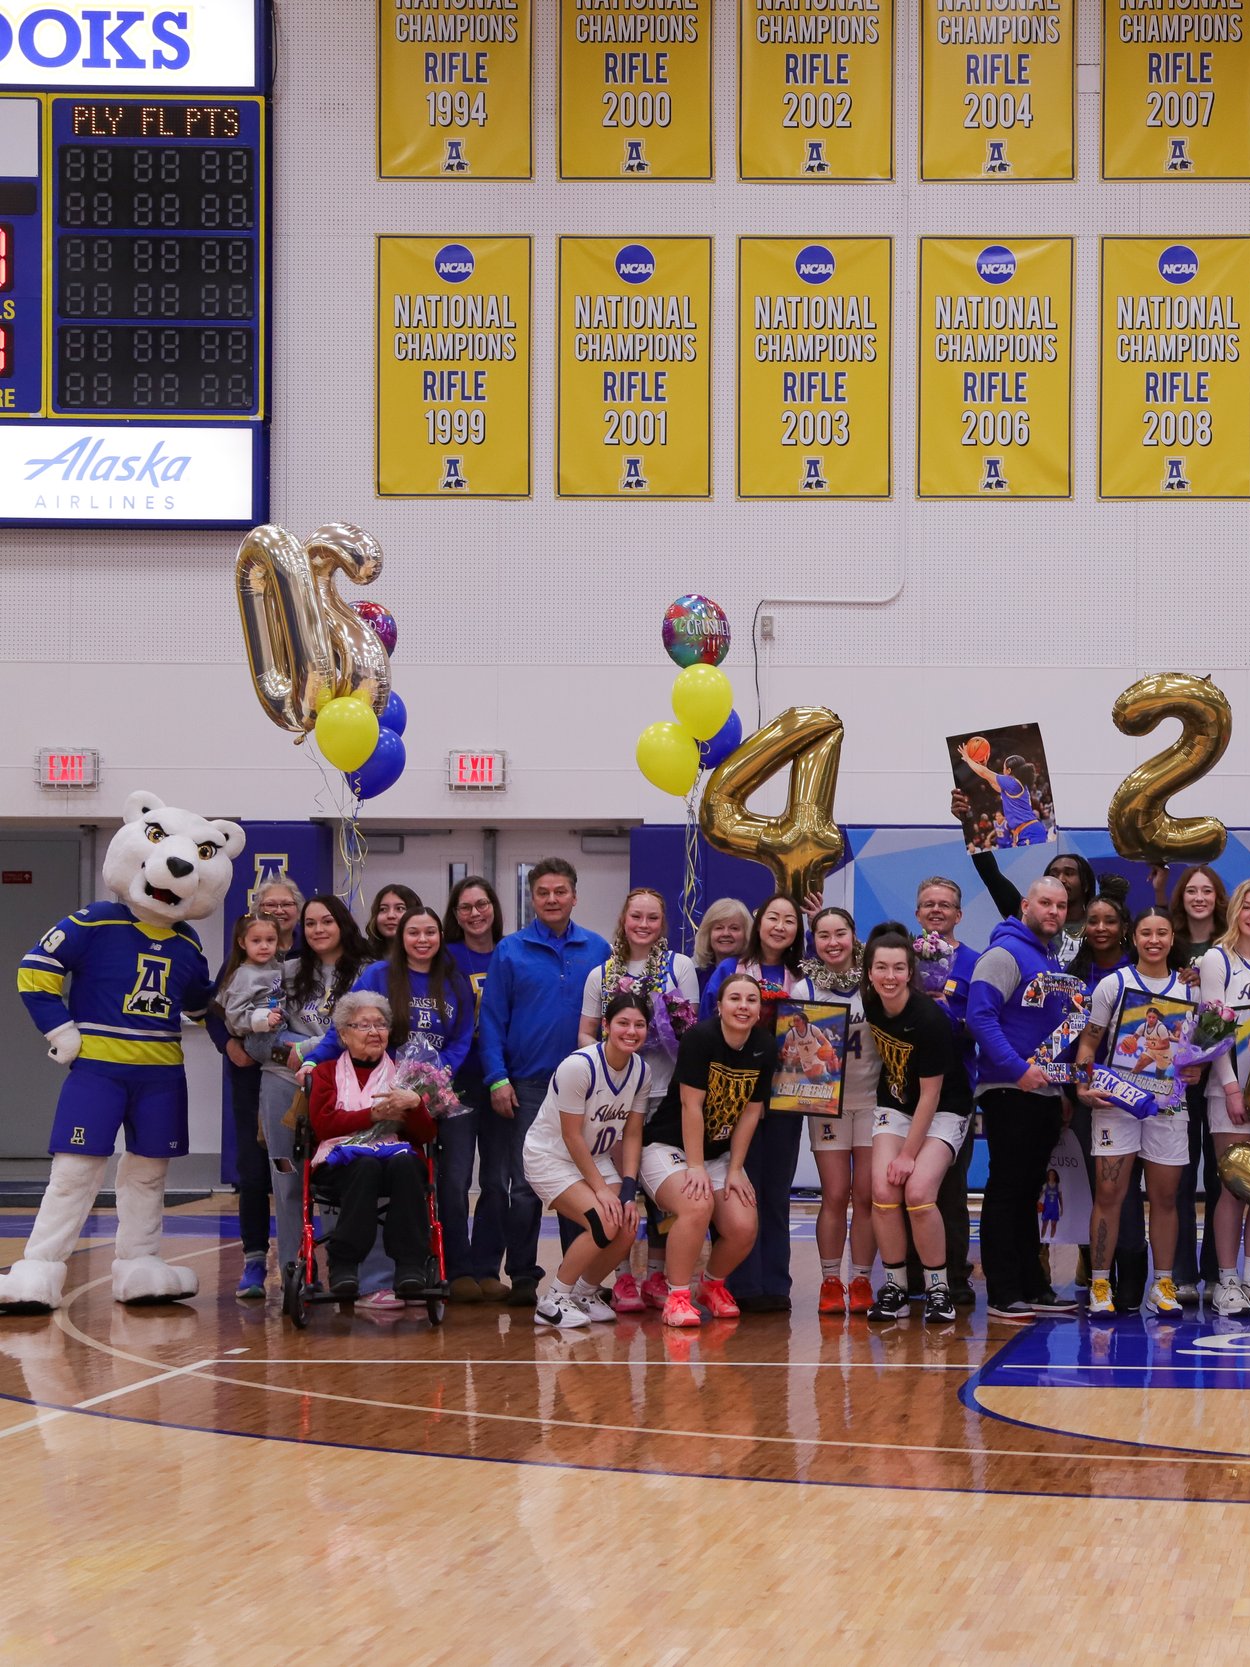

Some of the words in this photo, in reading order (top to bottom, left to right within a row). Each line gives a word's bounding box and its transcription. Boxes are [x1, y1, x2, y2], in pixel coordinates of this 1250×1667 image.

[0, 9, 190, 70] OKS
[396, 14, 518, 43] CHAMPIONS
[576, 14, 698, 43] CHAMPIONS
[756, 15, 879, 43] CHAMPIONS
[937, 16, 1060, 44] CHAMPIONS
[1118, 14, 1242, 43] CHAMPIONS
[424, 52, 488, 84] RIFLE
[604, 53, 668, 84] RIFLE
[785, 53, 849, 85] RIFLE
[966, 53, 1030, 85] RIFLE
[1148, 52, 1213, 84] RIFLE
[73, 106, 124, 136] PLY
[142, 106, 173, 136] FL
[186, 107, 239, 136] PTS
[426, 90, 488, 128] 1994
[602, 90, 672, 128] 2000
[782, 91, 852, 129] 2002
[963, 92, 1033, 129] 2004
[1146, 91, 1215, 128] 2007
[439, 262, 474, 274] NCAA
[619, 262, 655, 275] NCAA
[799, 263, 835, 275] NCAA
[980, 263, 1015, 275] NCAA
[1162, 263, 1198, 275] NCAA
[394, 295, 516, 328] NATIONAL
[574, 295, 696, 329] NATIONAL
[754, 296, 877, 329] NATIONAL
[935, 296, 1057, 329] NATIONAL
[1116, 296, 1240, 329] NATIONAL
[394, 333, 516, 361] CHAMPIONS
[574, 333, 696, 361] CHAMPIONS
[754, 334, 877, 362] CHAMPIONS
[935, 334, 1057, 362] CHAMPIONS
[1116, 334, 1240, 362] CHAMPIONS
[423, 370, 487, 403] RIFLE
[603, 371, 667, 403] RIFLE
[783, 371, 848, 403] RIFLE
[963, 371, 1028, 403] RIFLE
[1145, 371, 1210, 403] RIFLE
[424, 409, 486, 445] 1999
[603, 409, 668, 446] 2001
[781, 410, 850, 446] 2003
[961, 410, 1030, 446] 2006
[1142, 410, 1212, 447] 2008
[24, 437, 191, 482] Alaska
[35, 495, 174, 510] AIRLINES
[48, 755, 85, 781] EXIT
[459, 755, 495, 783] EXIT
[591, 1126, 617, 1156] 10
